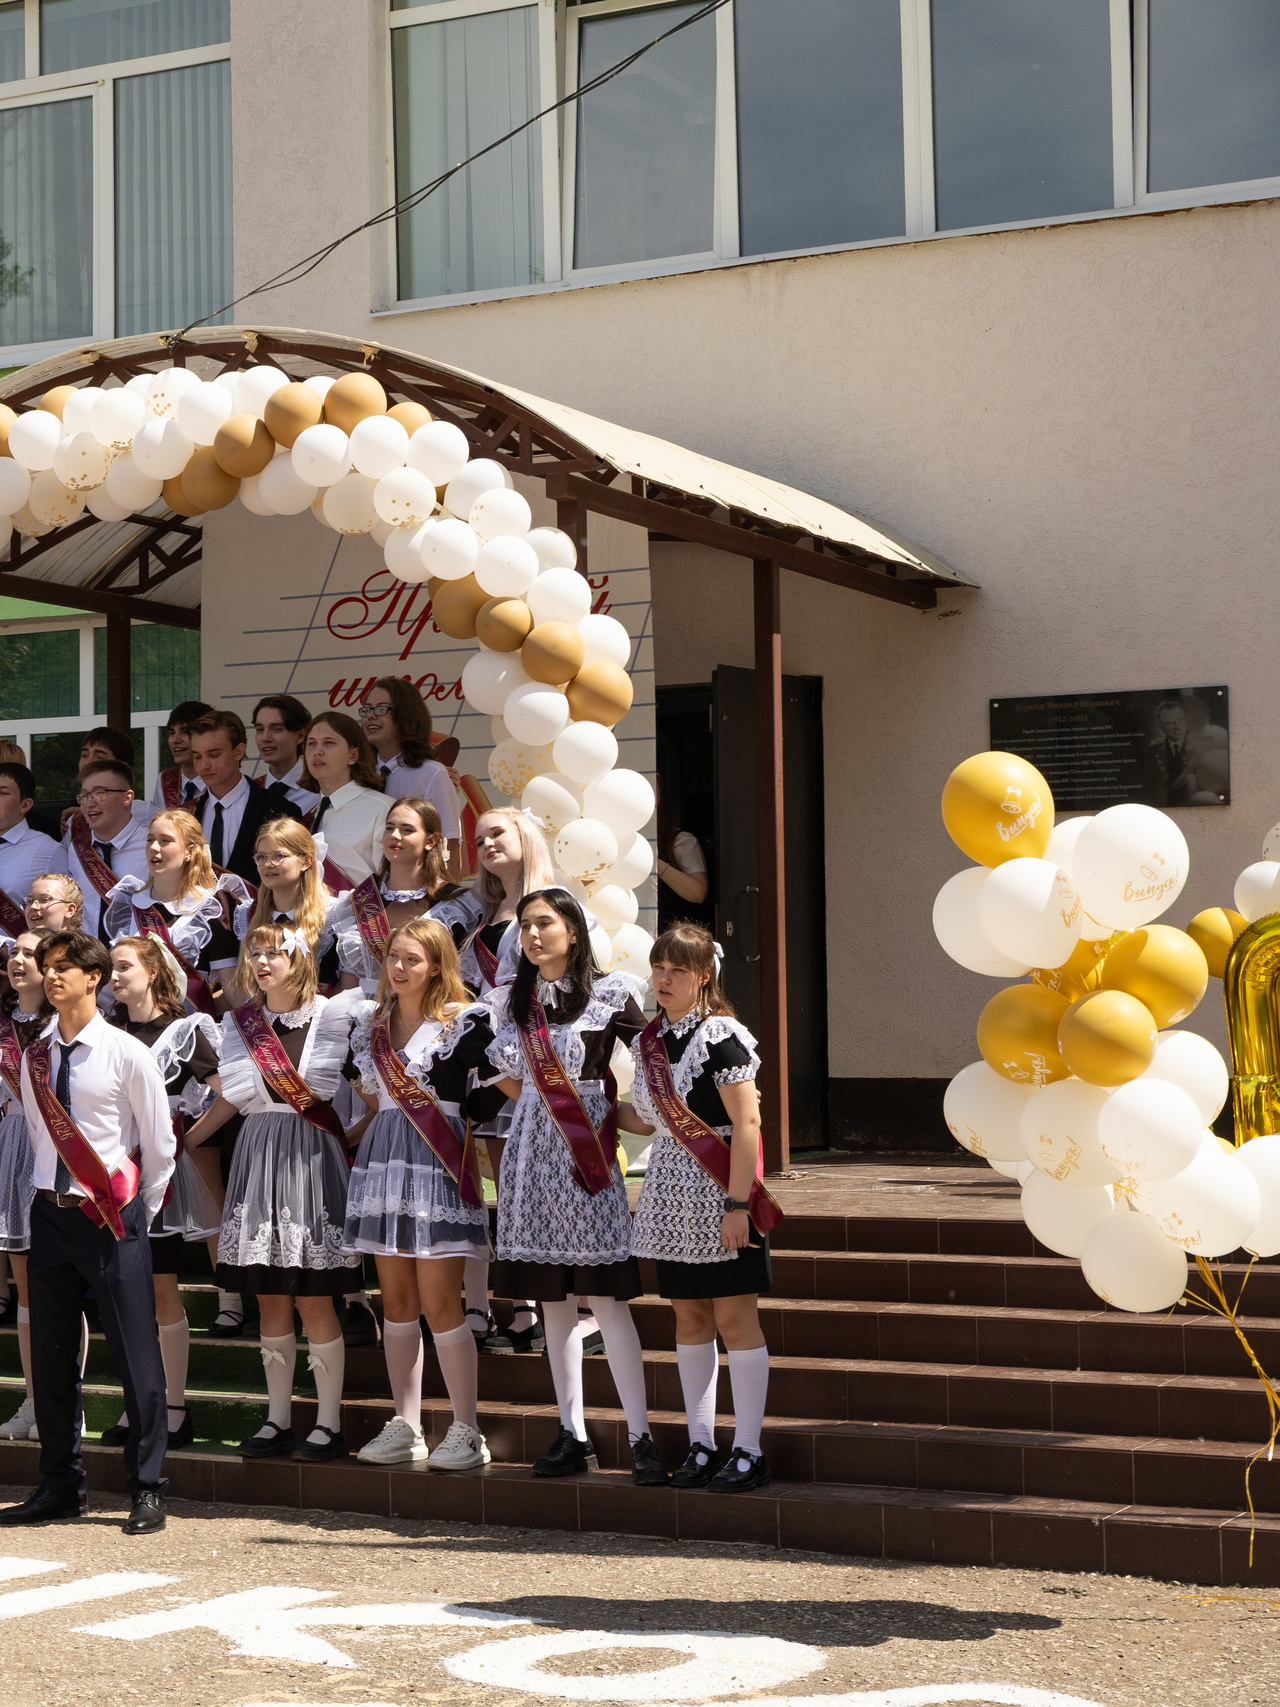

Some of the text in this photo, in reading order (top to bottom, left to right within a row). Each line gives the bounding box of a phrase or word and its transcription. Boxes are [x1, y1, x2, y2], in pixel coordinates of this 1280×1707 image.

[1047, 701, 1078, 709] Михаил
[1080, 699, 1120, 708] Иванович
[995, 789, 1043, 842] Выпуск!
[1123, 864, 1179, 903] Выпуск!
[253, 1033, 297, 1095] Выпускница
[290, 1091, 316, 1112] 202
[540, 1060, 566, 1086] 2026
[400, 1084, 430, 1109] 2026
[648, 1053, 679, 1120] Выпускница
[674, 1116, 708, 1140] 2026
[50, 1115, 75, 1141] 2026
